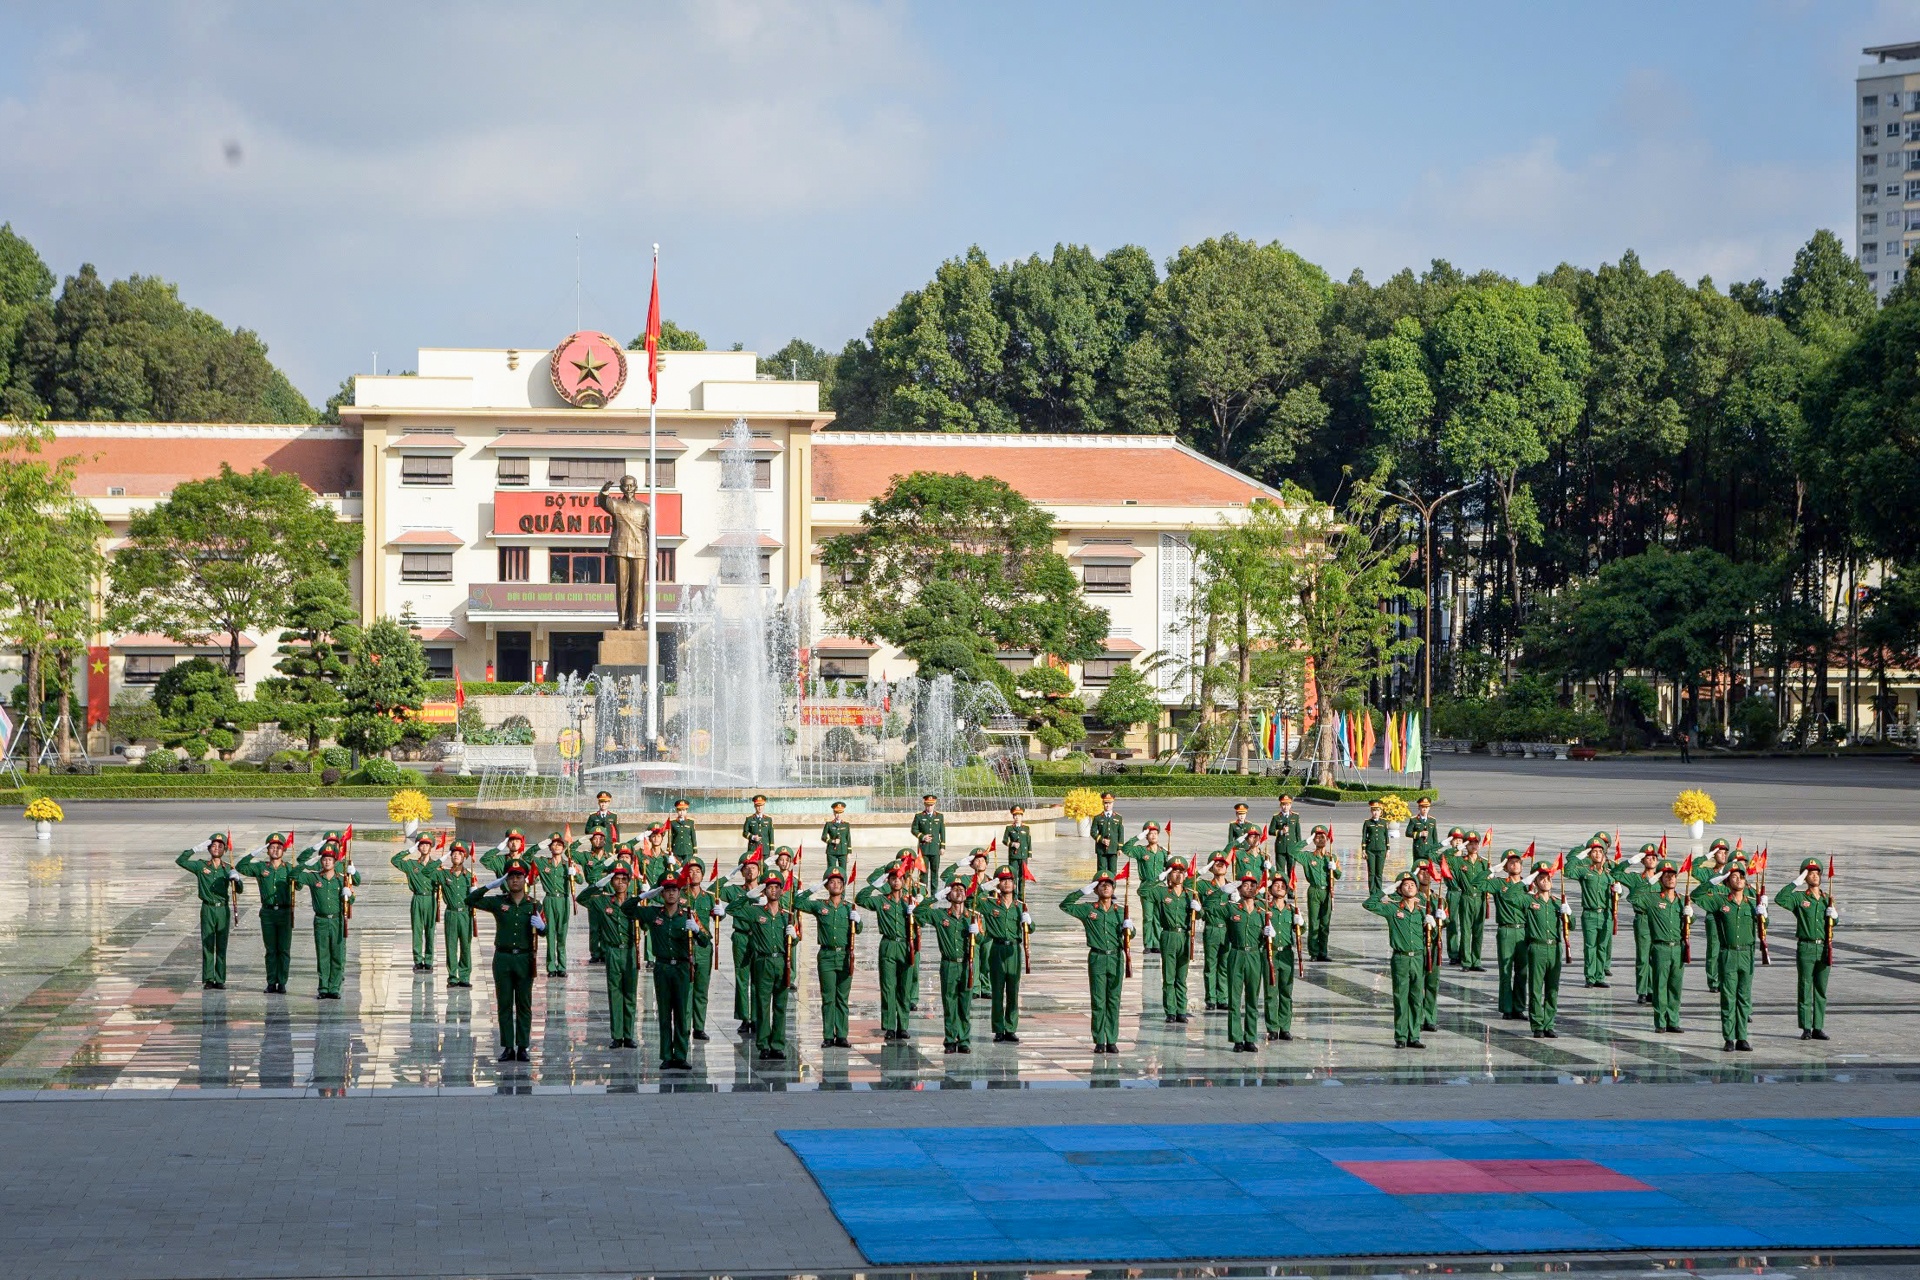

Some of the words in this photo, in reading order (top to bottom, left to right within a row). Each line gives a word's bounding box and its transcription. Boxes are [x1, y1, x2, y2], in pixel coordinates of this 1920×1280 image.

[545, 492, 566, 510] BỘ
[569, 495, 590, 508] TƯ
[518, 510, 582, 534] QUÂN
[588, 515, 613, 533] KH
